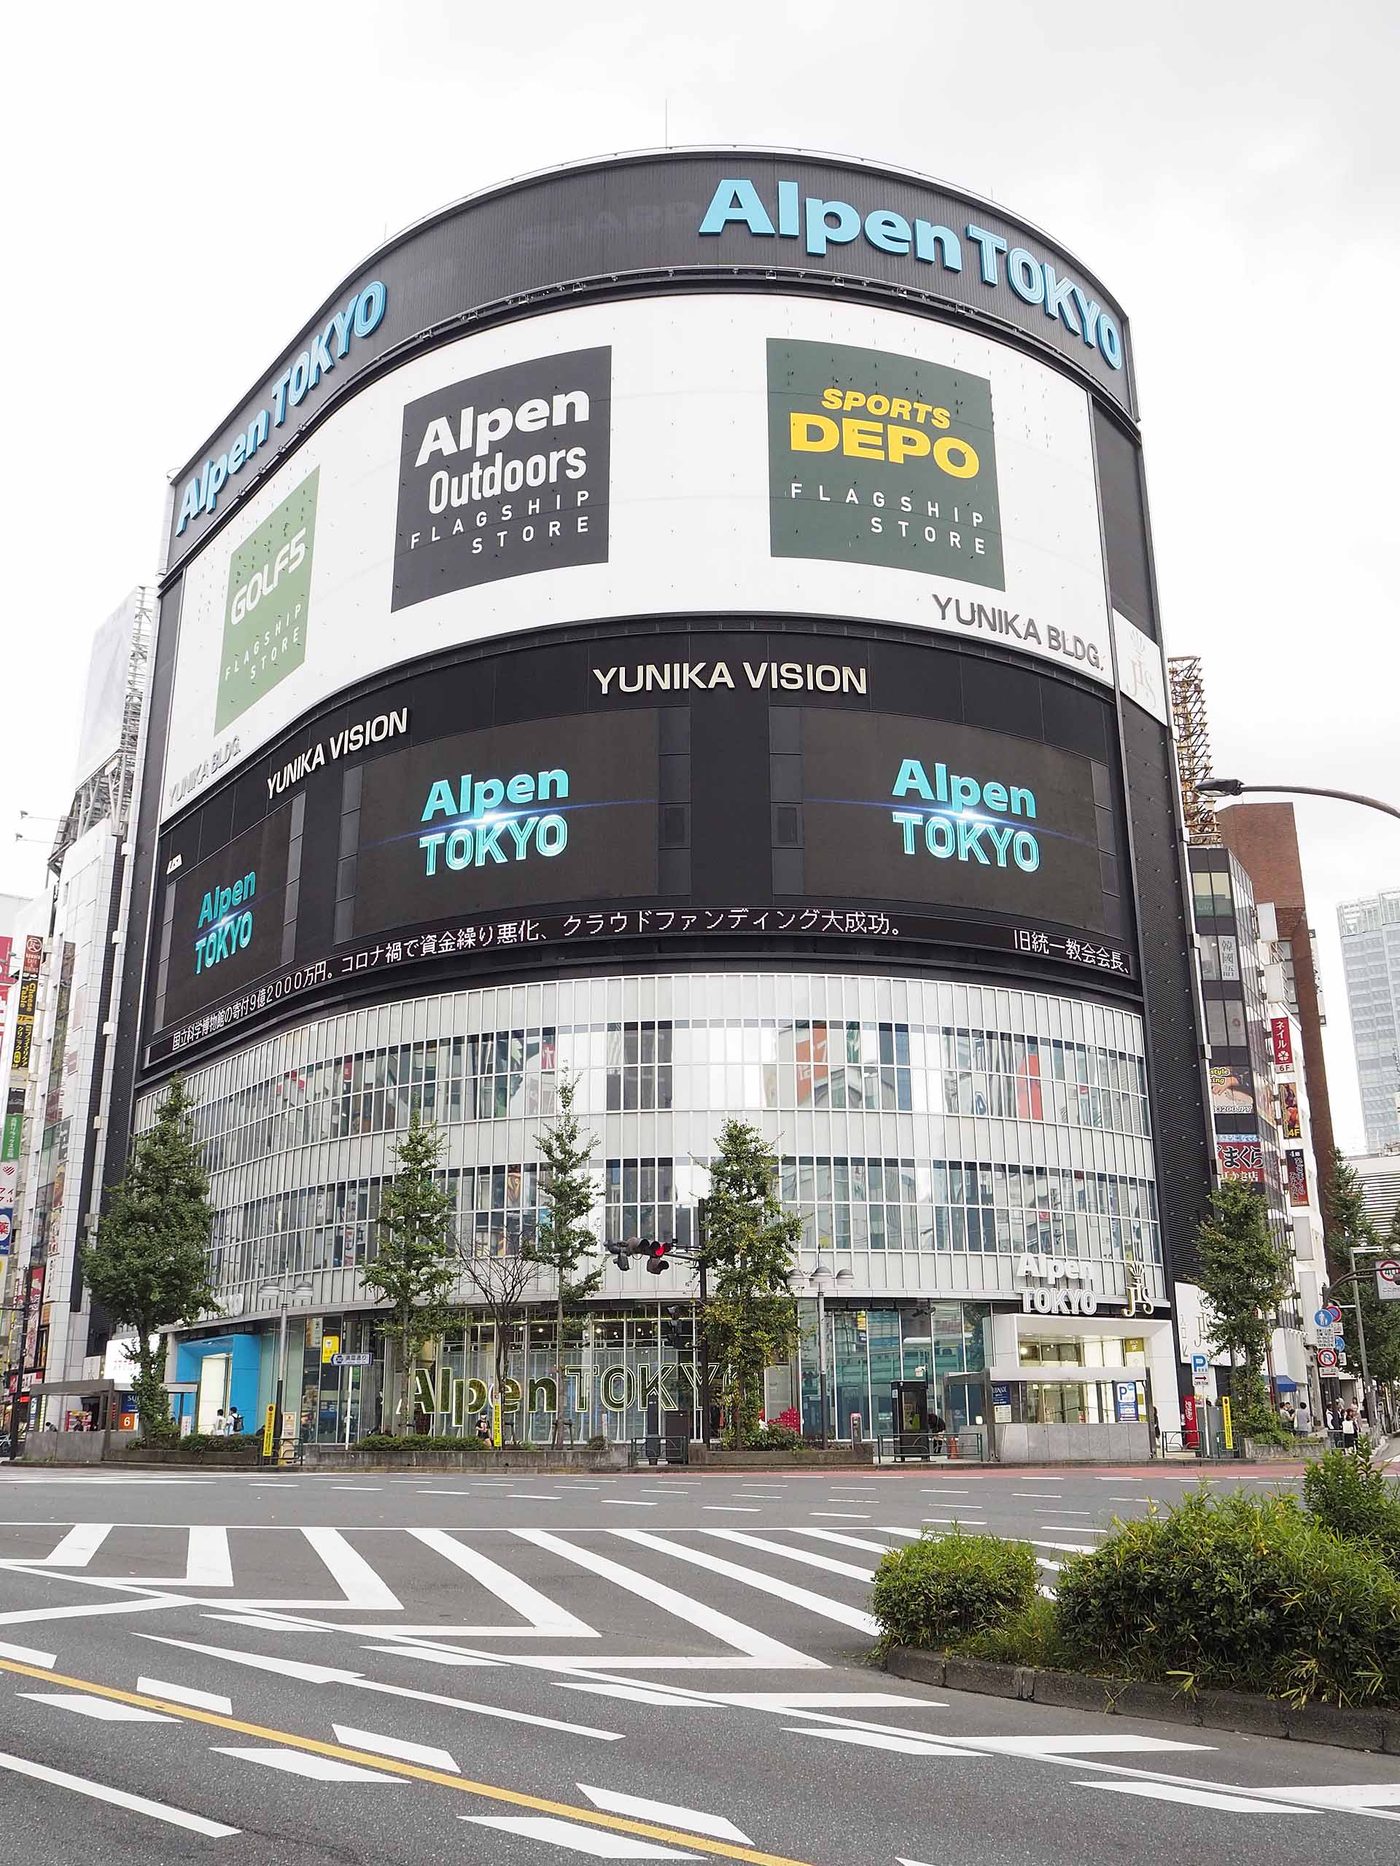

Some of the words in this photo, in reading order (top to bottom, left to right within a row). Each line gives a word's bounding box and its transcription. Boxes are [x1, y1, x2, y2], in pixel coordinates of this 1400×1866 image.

[699, 179, 962, 273] Alpen
[967, 223, 1123, 371] TOKYO
[176, 410, 270, 537] Alpen
[272, 281, 387, 428] TOKYO
[415, 391, 590, 467] Alpen
[821, 388, 951, 430] SPORTS
[790, 412, 980, 479] DEPO
[429, 447, 587, 515] Outdoors
[791, 483, 983, 527] FLAGSHIP
[410, 491, 589, 549] FLAGSHIP
[472, 517, 589, 554] STORE
[871, 517, 985, 555] STORE
[231, 528, 306, 625] GOLF5
[224, 604, 301, 681] FLAGSHIP
[250, 626, 300, 680] STORE
[932, 593, 1042, 645] YUNIKA
[1047, 624, 1104, 671] BLDG.
[593, 661, 736, 695] YUNIKA
[742, 662, 867, 695] VISION
[266, 743, 325, 799] YUNIKA
[328, 707, 409, 760] VISION
[168, 758, 209, 807] YUNIKA
[420, 768, 569, 822] Alpen
[892, 758, 1036, 819] Alpen
[419, 814, 568, 876] TOKYO
[892, 811, 1040, 873] TOKYO
[198, 871, 256, 929] Alpen
[195, 911, 253, 975] TOKYO
[1014, 929, 1129, 974] 旧統一教会会長、
[1276, 1021, 1287, 1049] ネイル
[1217, 1145, 1264, 1169] まくら
[1288, 1128, 1300, 1137] 4F
[1017, 1252, 1094, 1285] Alpen
[1019, 1287, 1098, 1316] TOKYO
[123, 1416, 131, 1427] 6
[396, 1367, 557, 1427] Alpen
